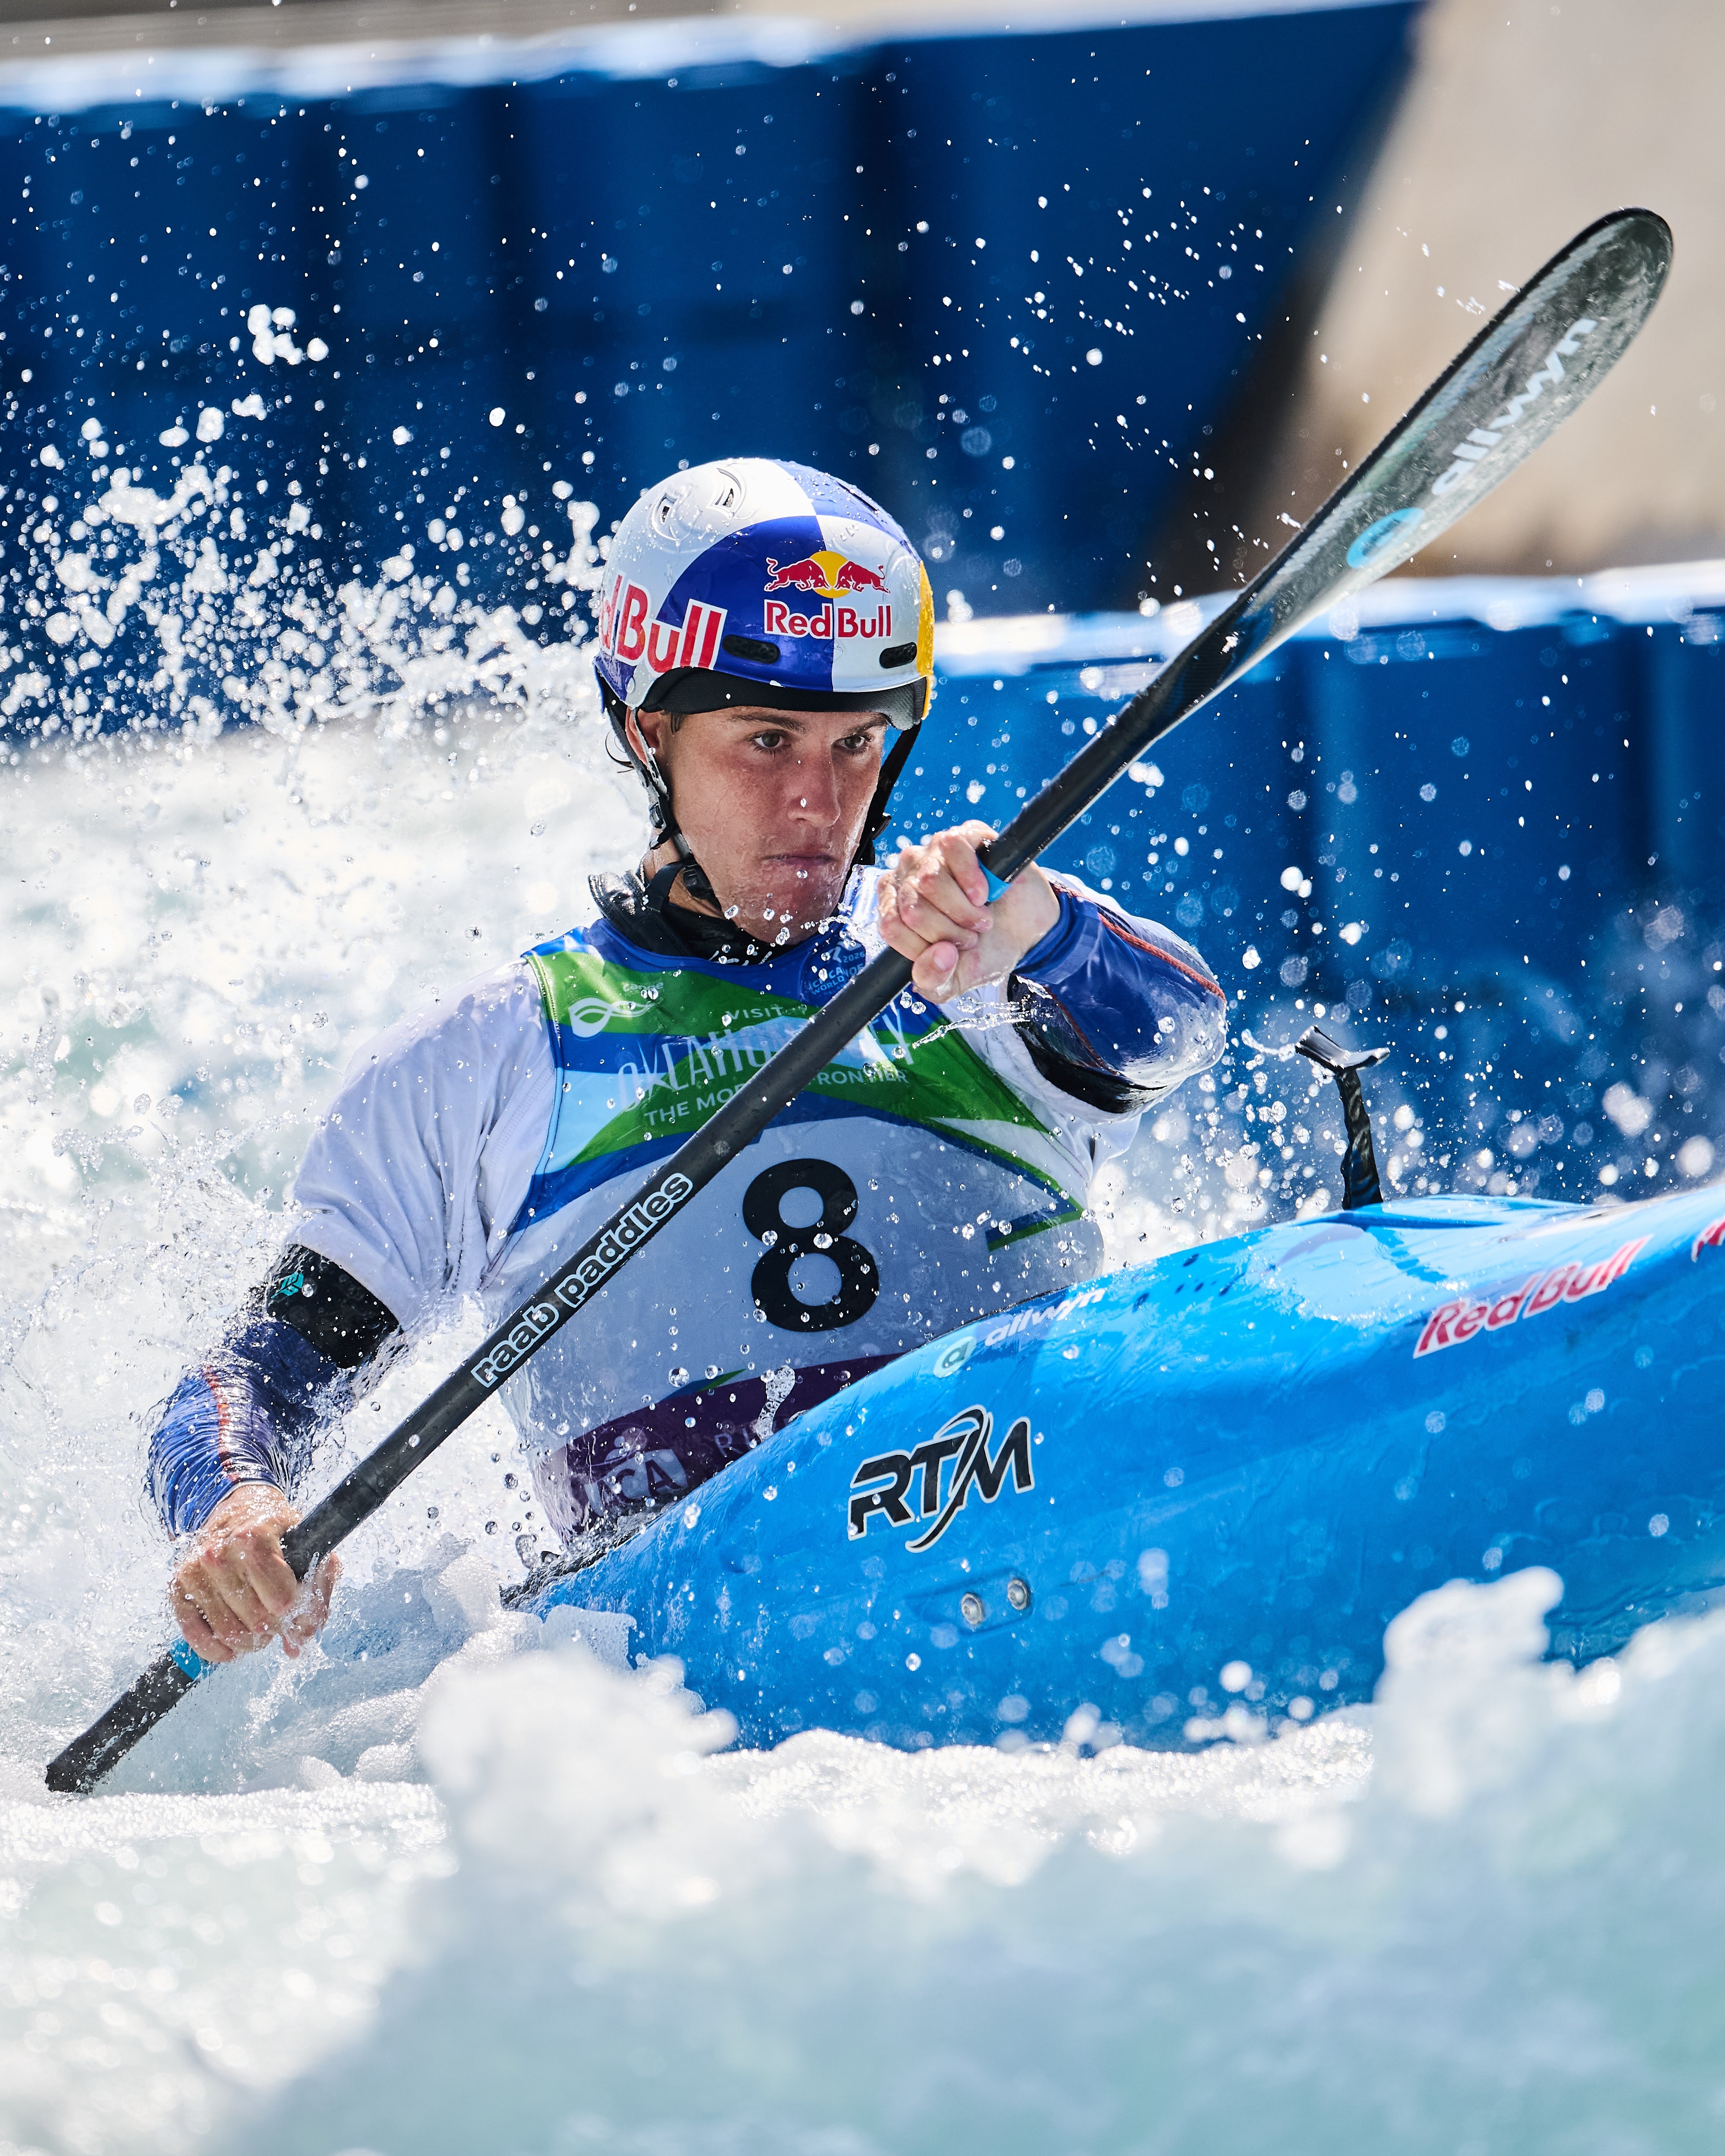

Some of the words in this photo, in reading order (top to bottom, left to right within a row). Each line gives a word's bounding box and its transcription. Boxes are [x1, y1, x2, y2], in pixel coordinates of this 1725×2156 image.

[1431, 318, 1598, 495] allwyn
[616, 583, 723, 674] Bull
[766, 601, 831, 638] Red
[837, 605, 892, 639] Bull
[811, 975, 845, 995] WORLD
[842, 951, 866, 963] 2026
[726, 1006, 783, 1020] VISIT
[618, 1025, 792, 1112] OKLAHO
[644, 1101, 690, 1126] THE
[470, 1302, 560, 1388] raab
[554, 1172, 693, 1308] paddles
[742, 1157, 880, 1333] 8
[984, 1288, 1106, 1347] allwyn
[1415, 1272, 1541, 1355] Red
[1527, 1236, 1650, 1317] Bull
[848, 1405, 1035, 1553] RTM
